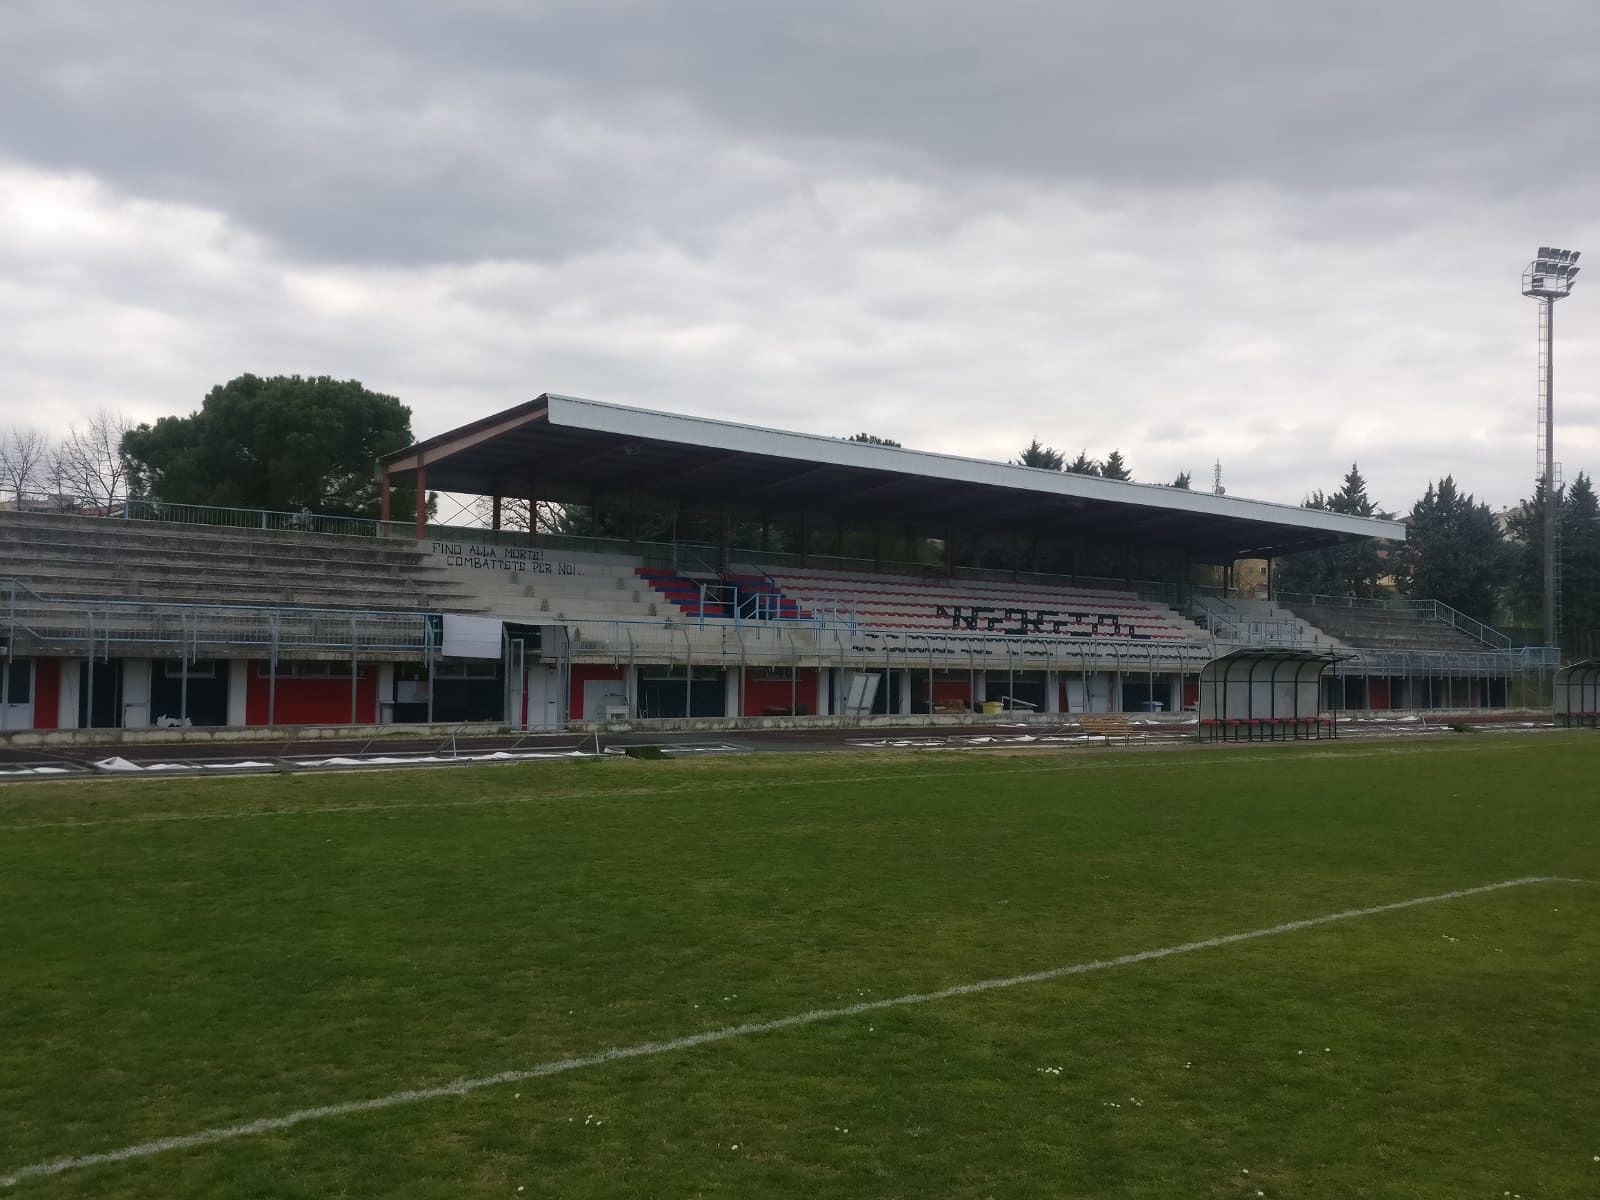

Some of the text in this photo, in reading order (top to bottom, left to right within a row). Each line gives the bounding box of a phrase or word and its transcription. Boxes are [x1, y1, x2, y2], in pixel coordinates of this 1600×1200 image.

[432, 542, 462, 555] FINO
[469, 544, 496, 558] ALLA
[446, 555, 526, 572] COMBATTETE
[532, 561, 552, 575] PER
